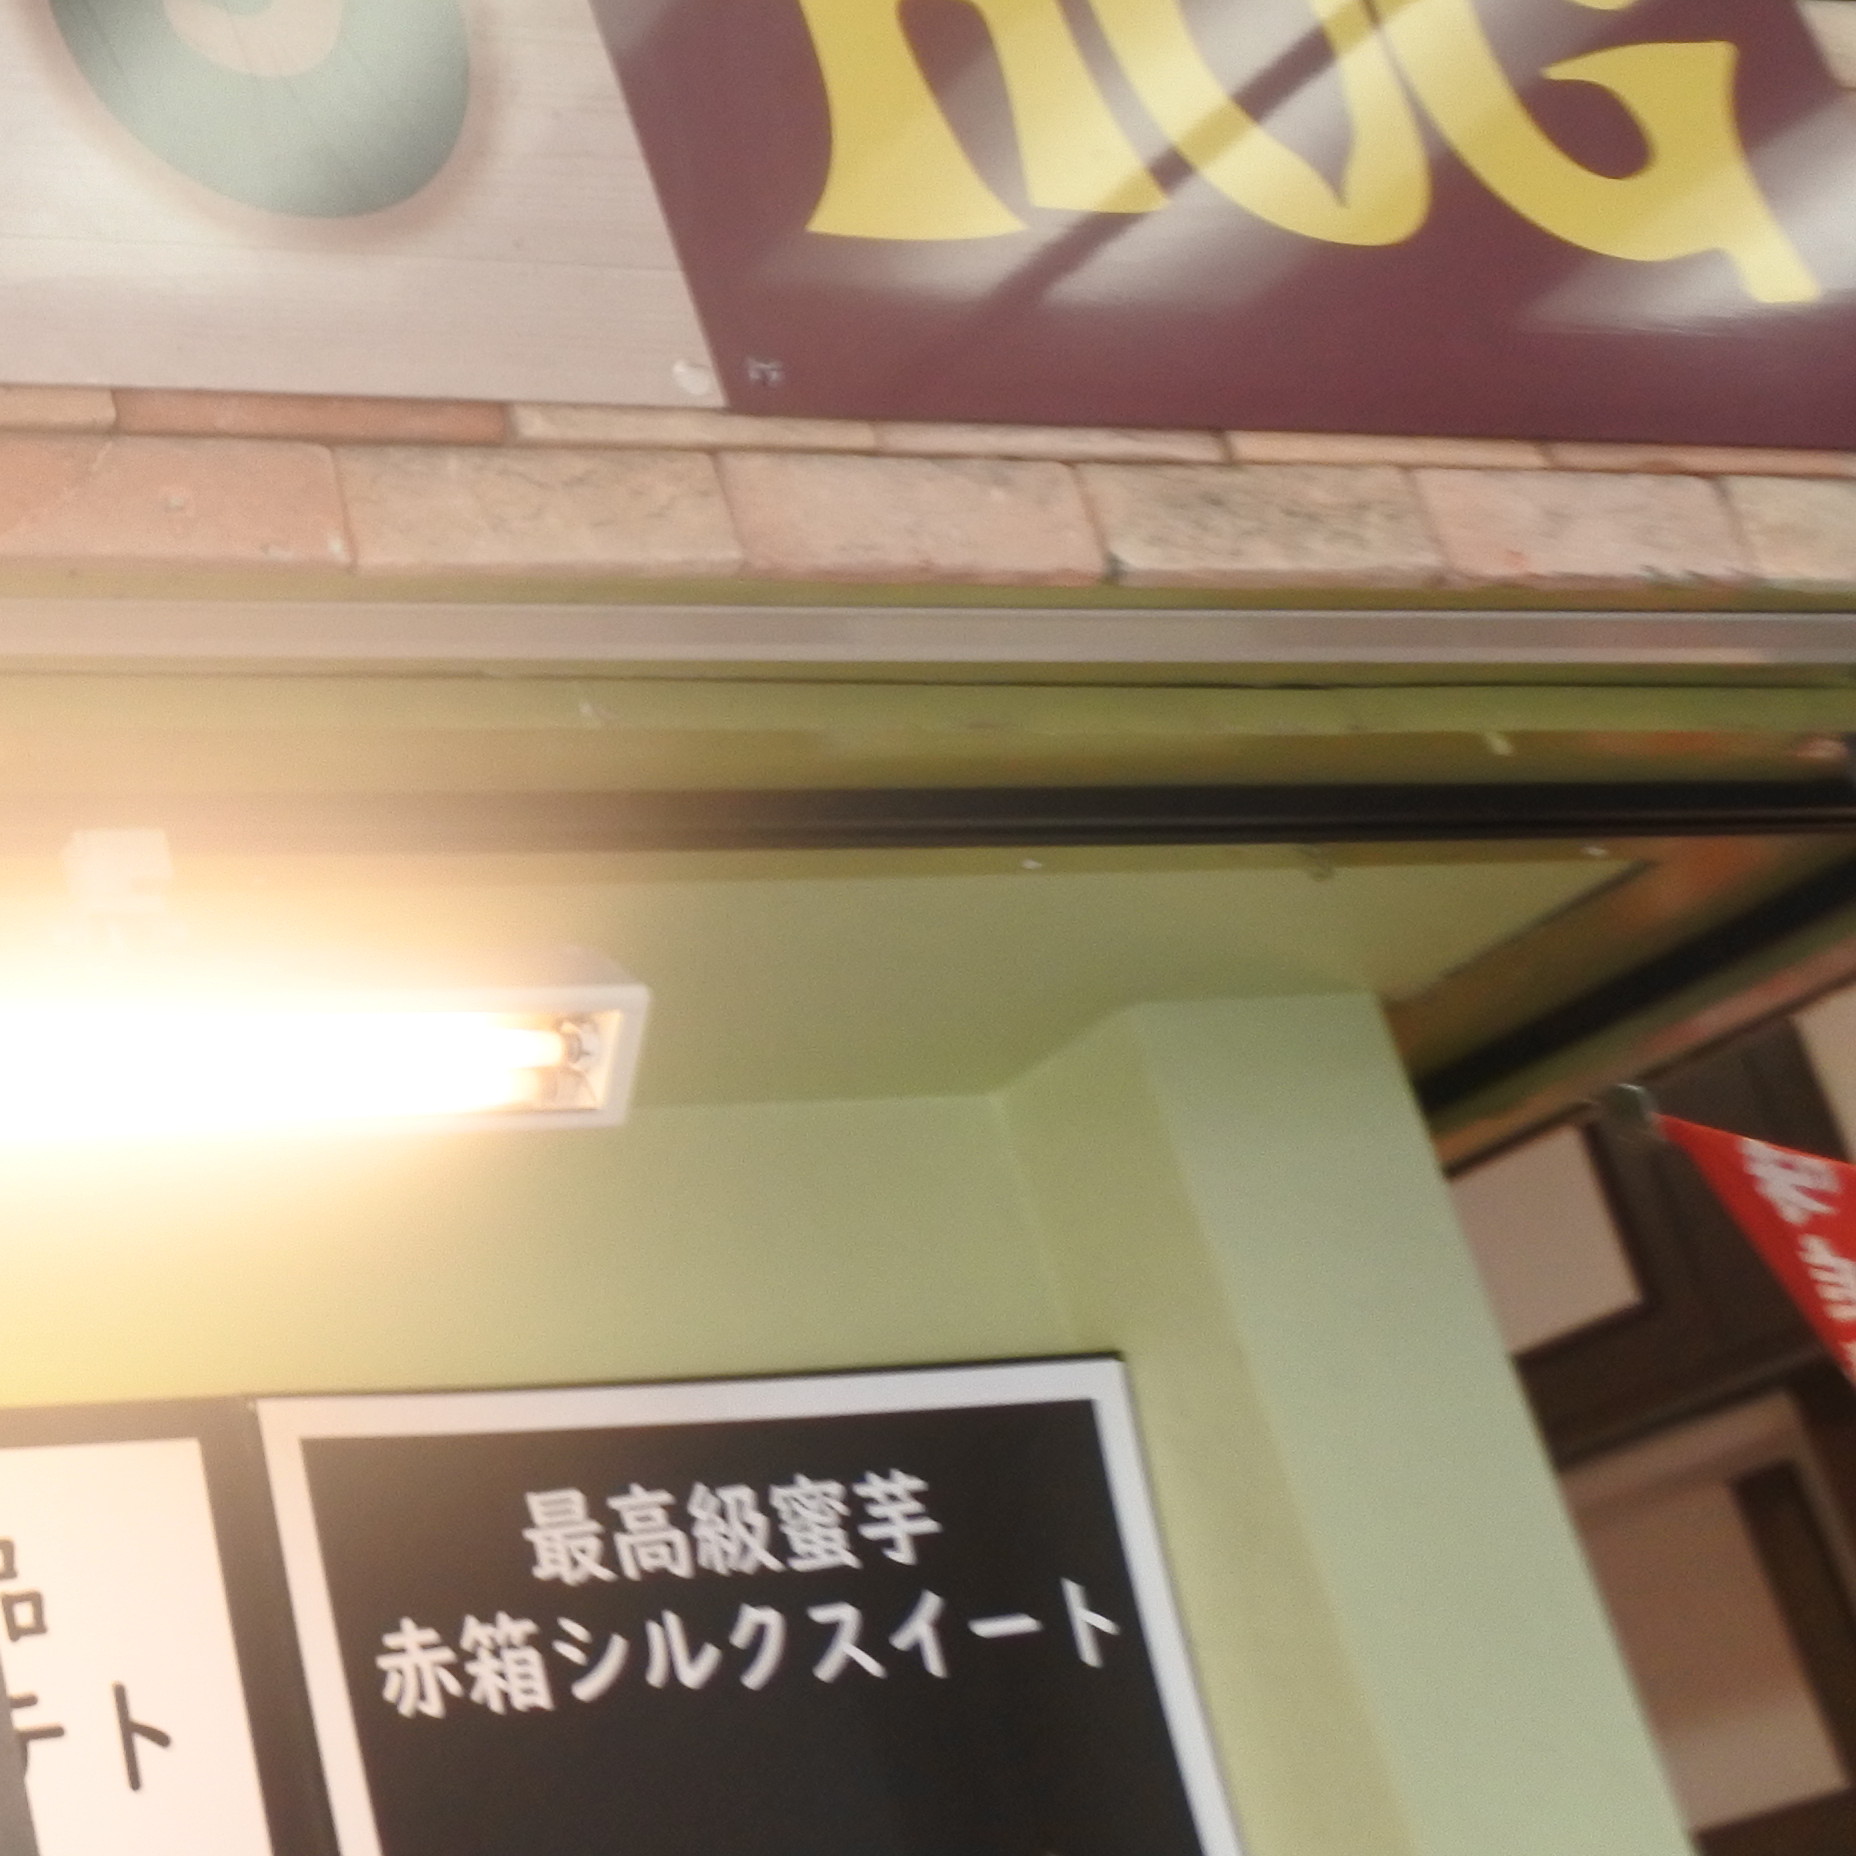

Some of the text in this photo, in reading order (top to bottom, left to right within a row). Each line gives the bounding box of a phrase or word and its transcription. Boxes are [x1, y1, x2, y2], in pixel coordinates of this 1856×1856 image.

[520, 1468, 943, 1586] 最高級蜜芋
[374, 1577, 1120, 1720] 赤箱シルクスイート
